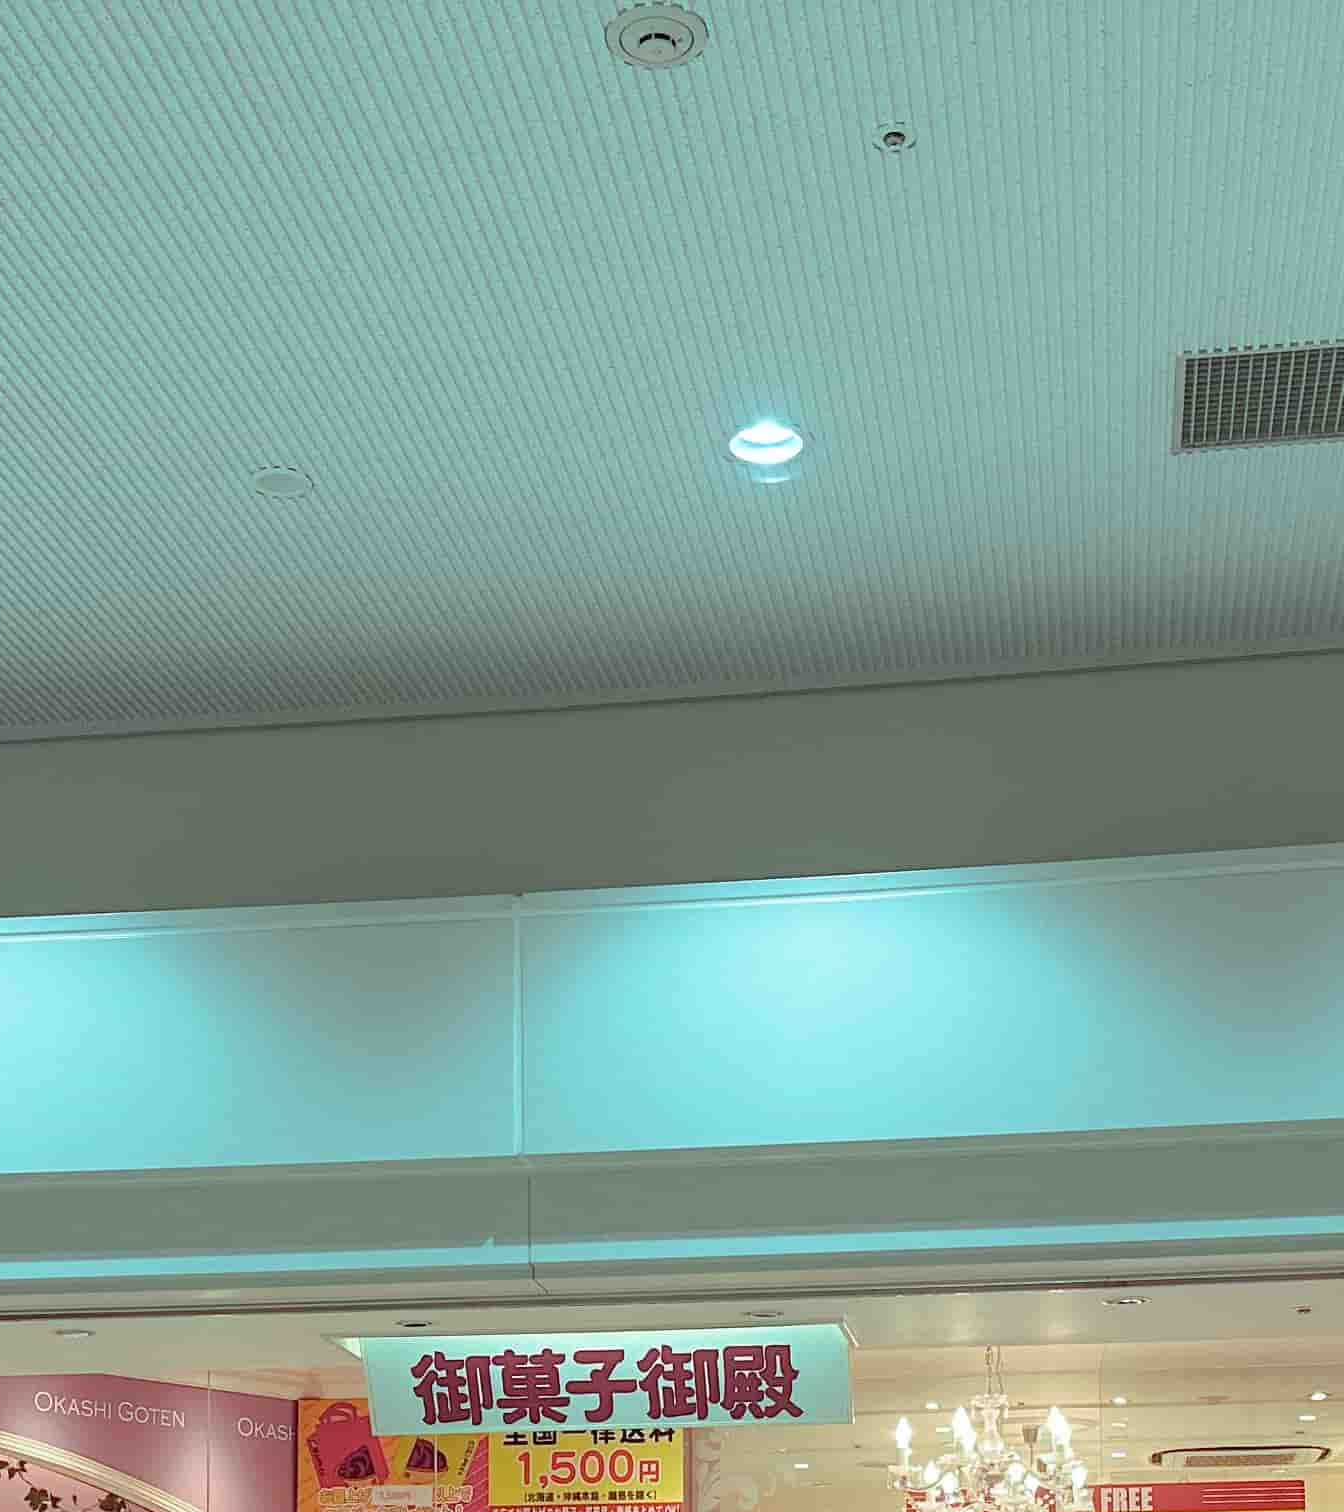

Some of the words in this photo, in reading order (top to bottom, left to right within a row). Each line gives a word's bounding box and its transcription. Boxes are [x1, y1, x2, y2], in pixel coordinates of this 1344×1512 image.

[411, 1344, 805, 1426] 御菓子御殿
[34, 1391, 112, 1420] OKASHI
[118, 1401, 186, 1428] GOTEN
[516, 1449, 661, 1488] 1,500円
[1100, 1486, 1153, 1512] FREE
